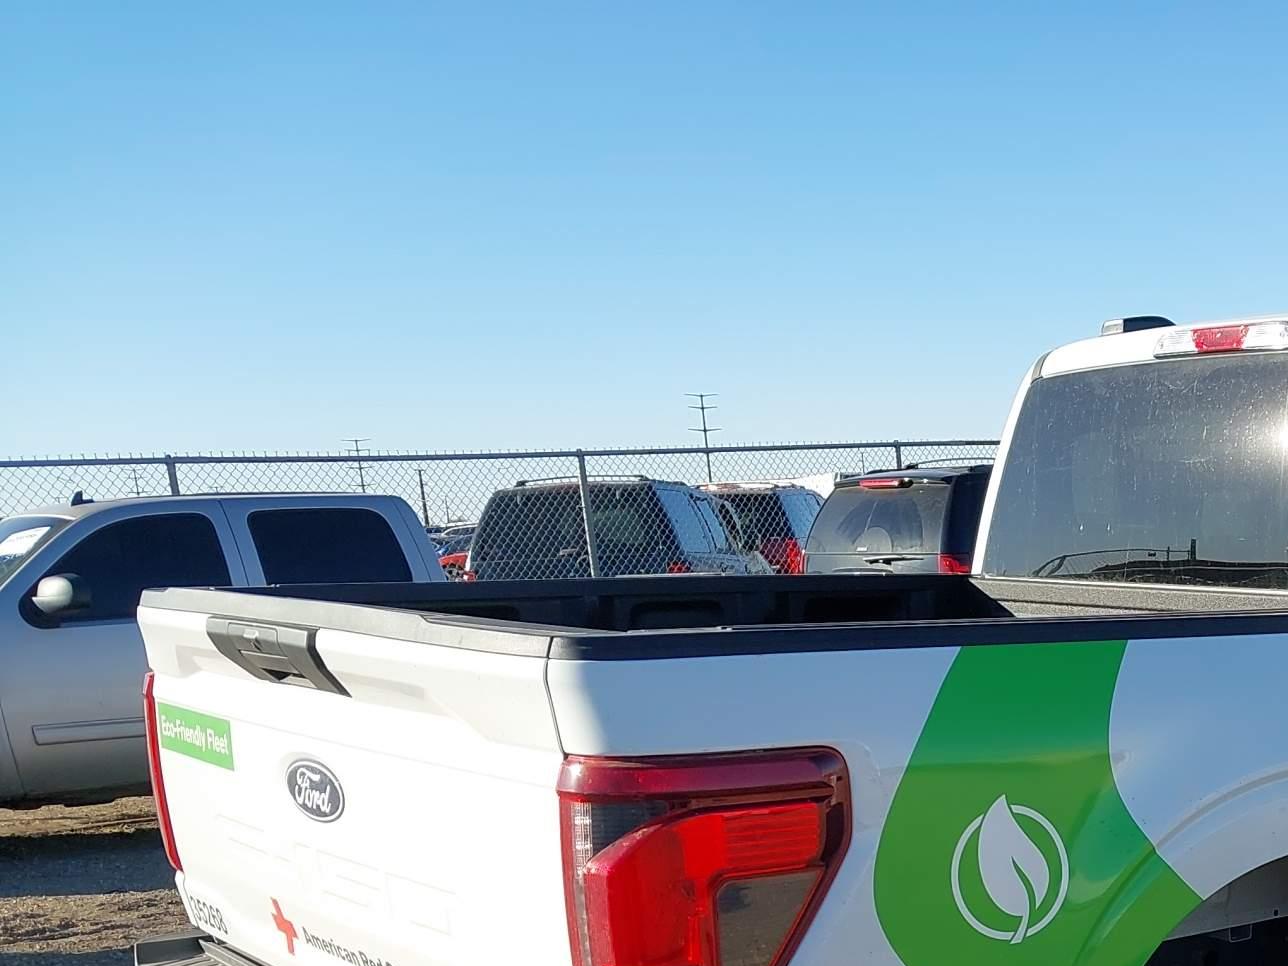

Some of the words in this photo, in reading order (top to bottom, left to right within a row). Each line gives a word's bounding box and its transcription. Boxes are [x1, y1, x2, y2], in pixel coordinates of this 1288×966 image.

[160, 714, 205, 752] Eco-Friendly
[206, 727, 229, 756] Fleet
[294, 767, 332, 813] Ford
[189, 895, 228, 935] 35268
[302, 926, 361, 966] American
